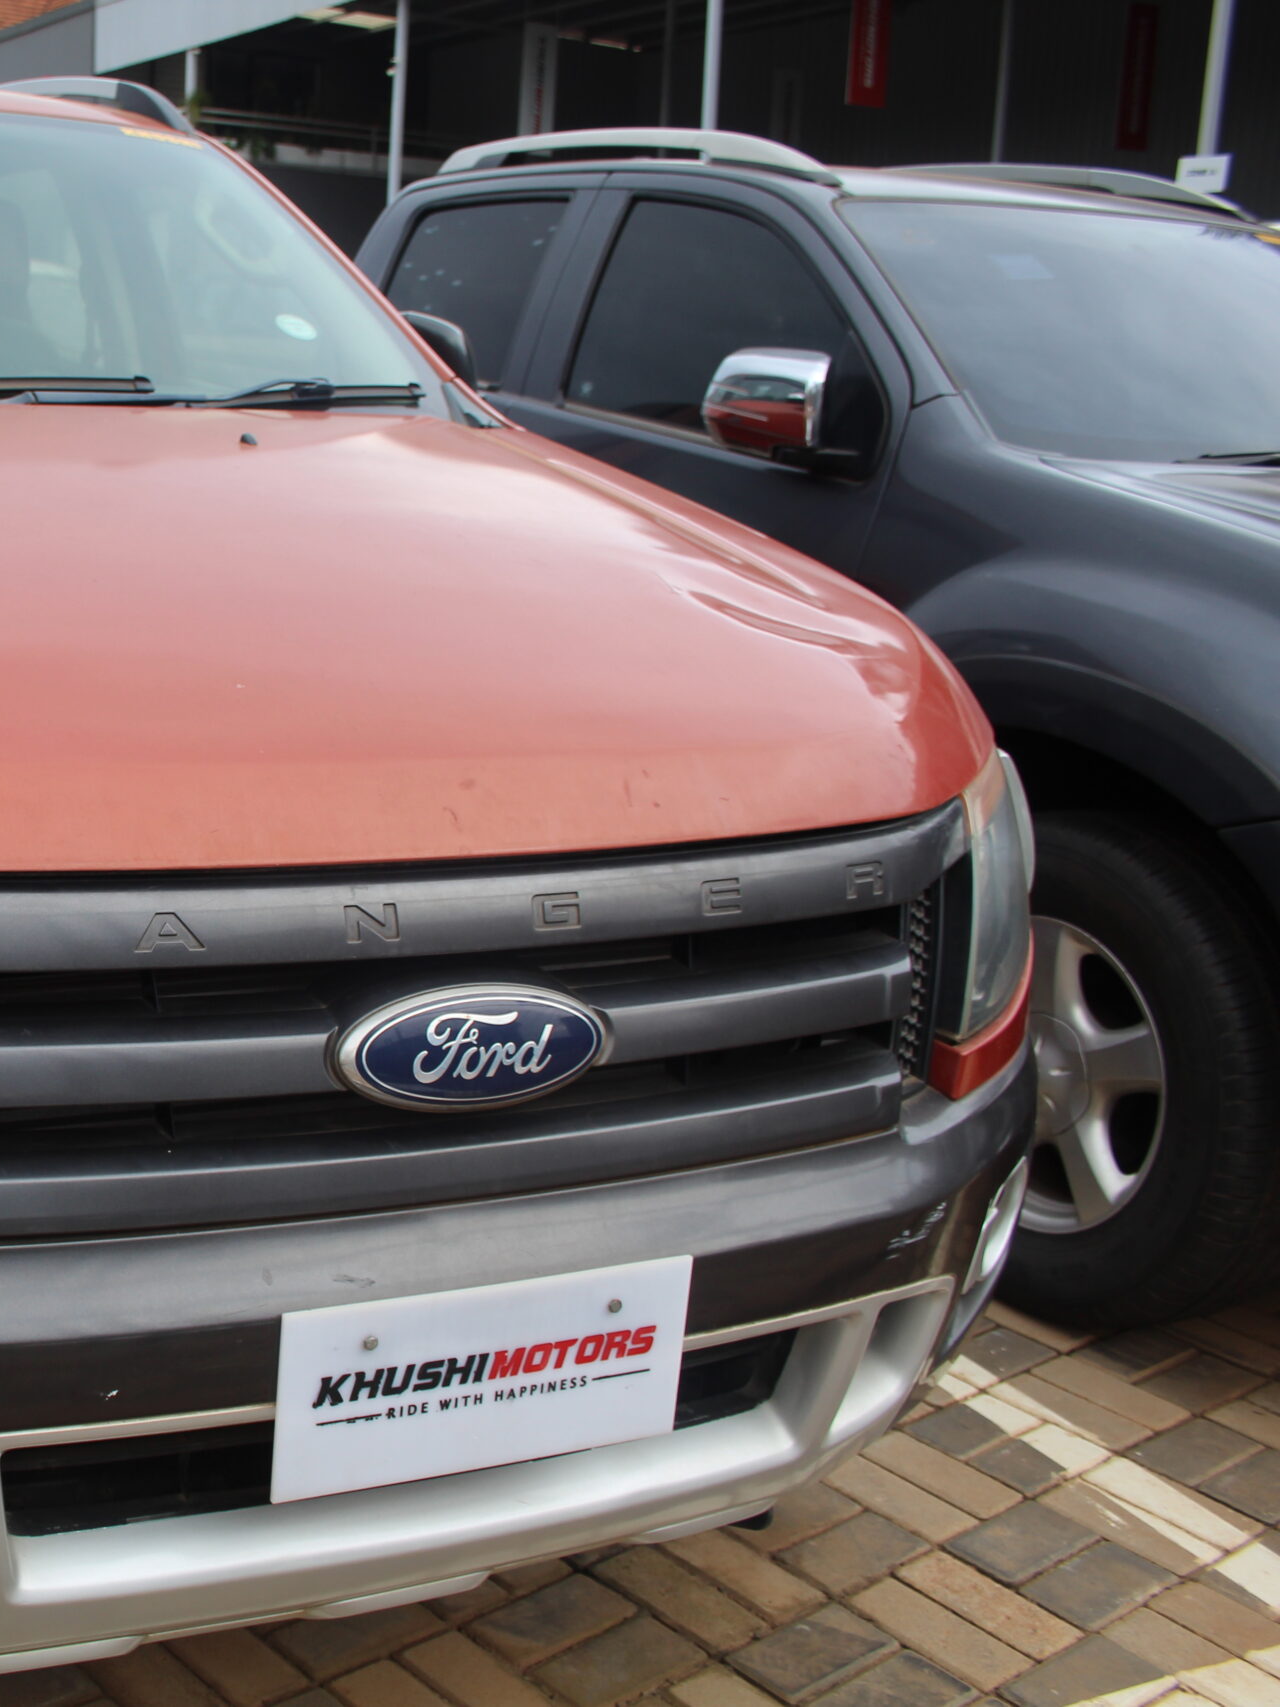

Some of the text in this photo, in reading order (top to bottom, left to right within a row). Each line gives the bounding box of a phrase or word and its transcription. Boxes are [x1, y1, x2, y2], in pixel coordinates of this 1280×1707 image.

[412, 1010, 552, 1084] Ford
[386, 1375, 588, 1420] RIDE WITH HAPPINESS
